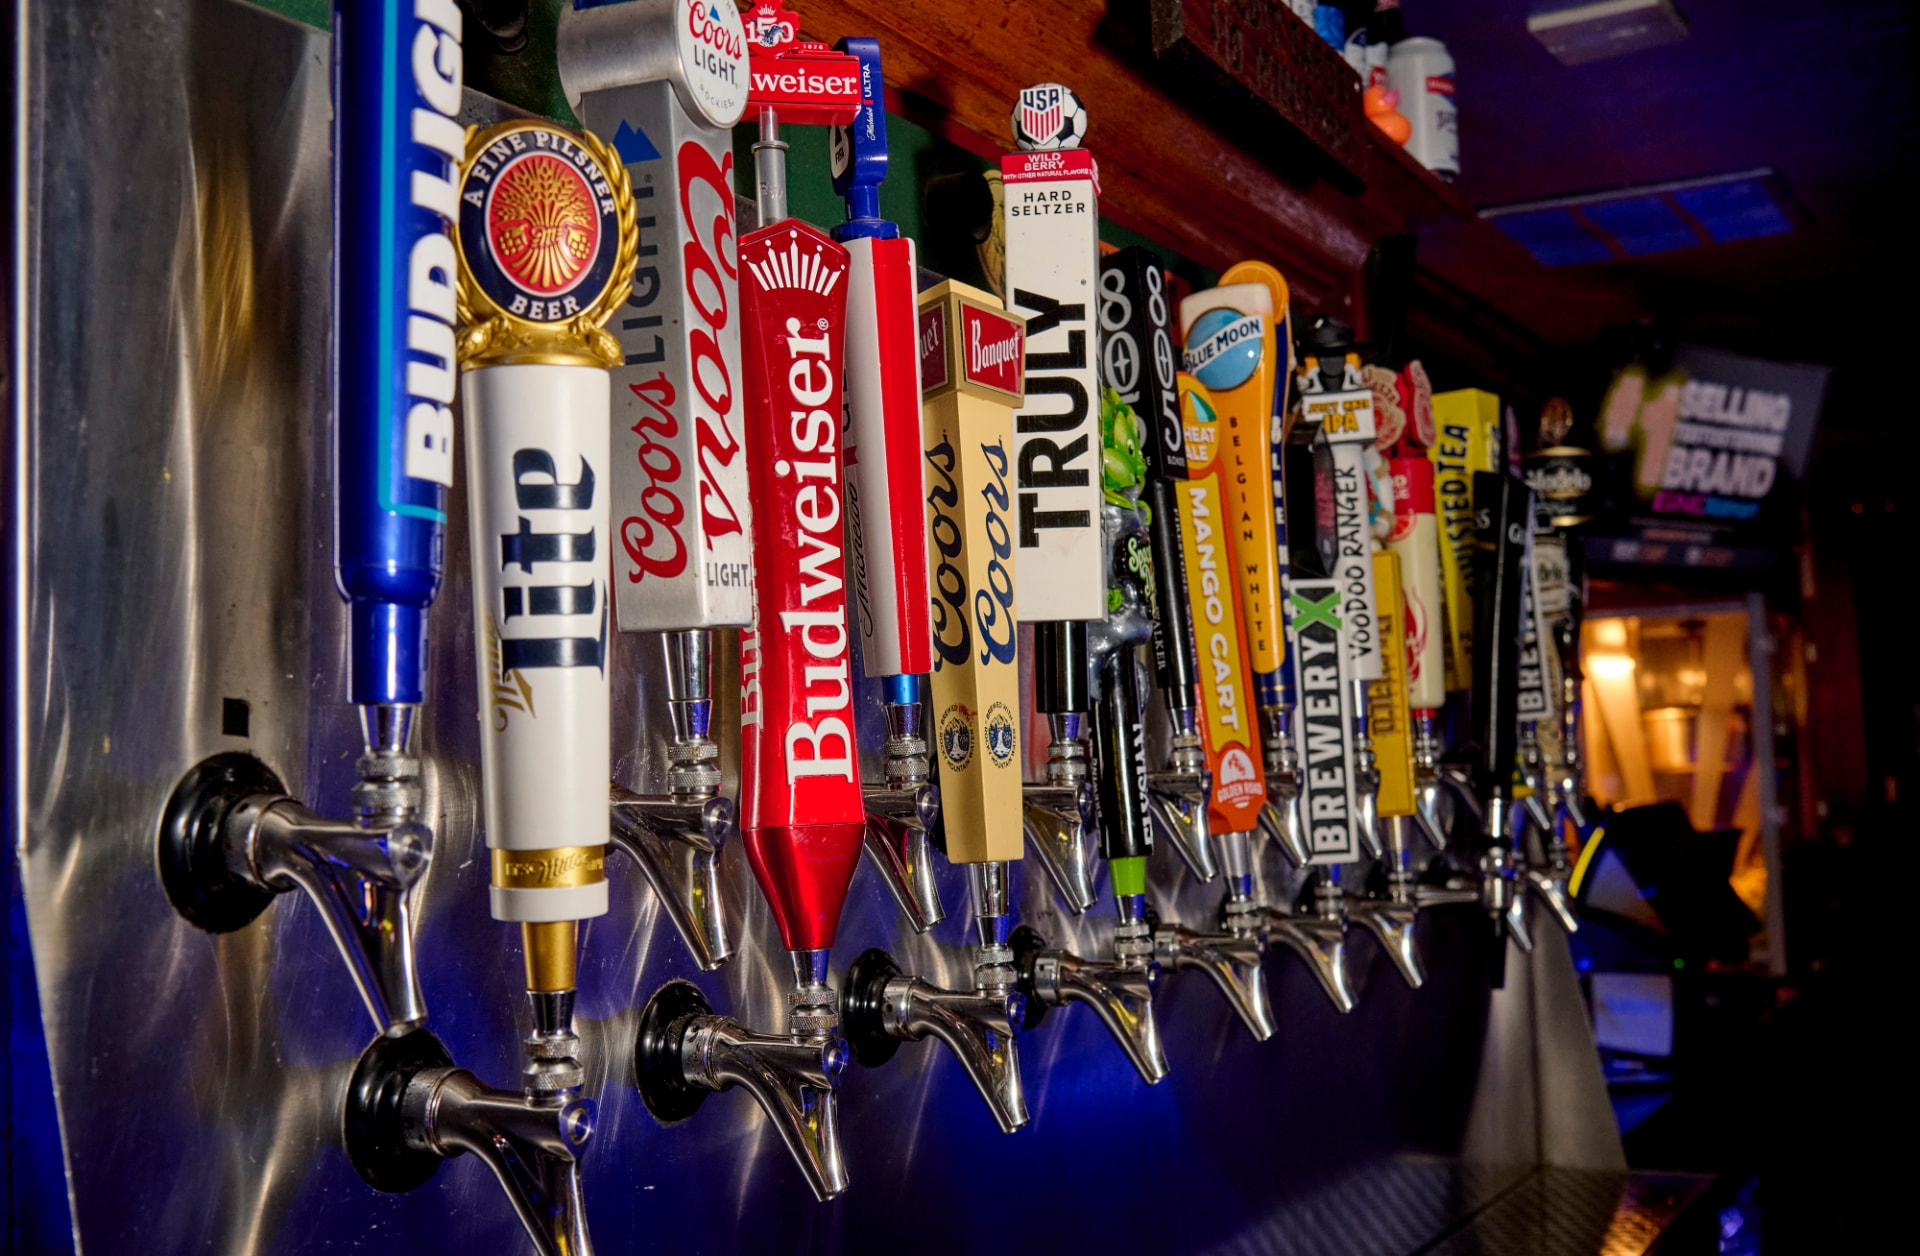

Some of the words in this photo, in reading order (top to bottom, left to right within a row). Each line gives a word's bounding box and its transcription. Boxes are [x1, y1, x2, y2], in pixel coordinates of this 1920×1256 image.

[687, 0, 742, 60] Coors
[745, 16, 794, 47] 150
[694, 44, 736, 86] LIGHT
[749, 68, 854, 95] weiser
[862, 63, 873, 98] ULTRA
[411, 0, 464, 228] LIG
[1022, 88, 1060, 111] USA
[471, 131, 527, 187] FINE
[533, 129, 615, 216] PILSNER
[1018, 172, 1036, 180] OTHER
[1024, 160, 1065, 171] BERRY
[1028, 152, 1061, 162] WILD
[463, 188, 483, 208] A
[1011, 202, 1085, 217] SELTZER
[1023, 190, 1072, 203] HARD
[508, 294, 581, 320] BEER
[405, 233, 457, 488] BUD
[678, 140, 743, 551] Coors
[971, 317, 1020, 378] Banquet
[1146, 264, 1182, 453] 805
[1184, 342, 1215, 373] BLUE
[1215, 317, 1262, 351] MOON
[1014, 287, 1091, 548] TRULY
[1184, 426, 1216, 444] HEAT
[1323, 411, 1359, 433] IPA
[1185, 445, 1208, 461] ALE
[1436, 423, 1470, 473] TEA
[1663, 447, 1777, 499] BRAND
[620, 370, 688, 583] Coors
[1229, 416, 1253, 542] BELGIAN
[1246, 563, 1266, 652] WHITE
[1334, 466, 1364, 556] RANGER
[499, 447, 608, 682] Lite
[706, 562, 749, 588] LIGHT
[774, 316, 853, 785] Budweiser
[924, 431, 971, 672] Coors
[975, 436, 1016, 665] Coors
[1189, 487, 1224, 625] MANGO
[1210, 632, 1239, 732] CART
[1344, 566, 1372, 660] VOODOO
[1302, 634, 1351, 854] BREWERY
